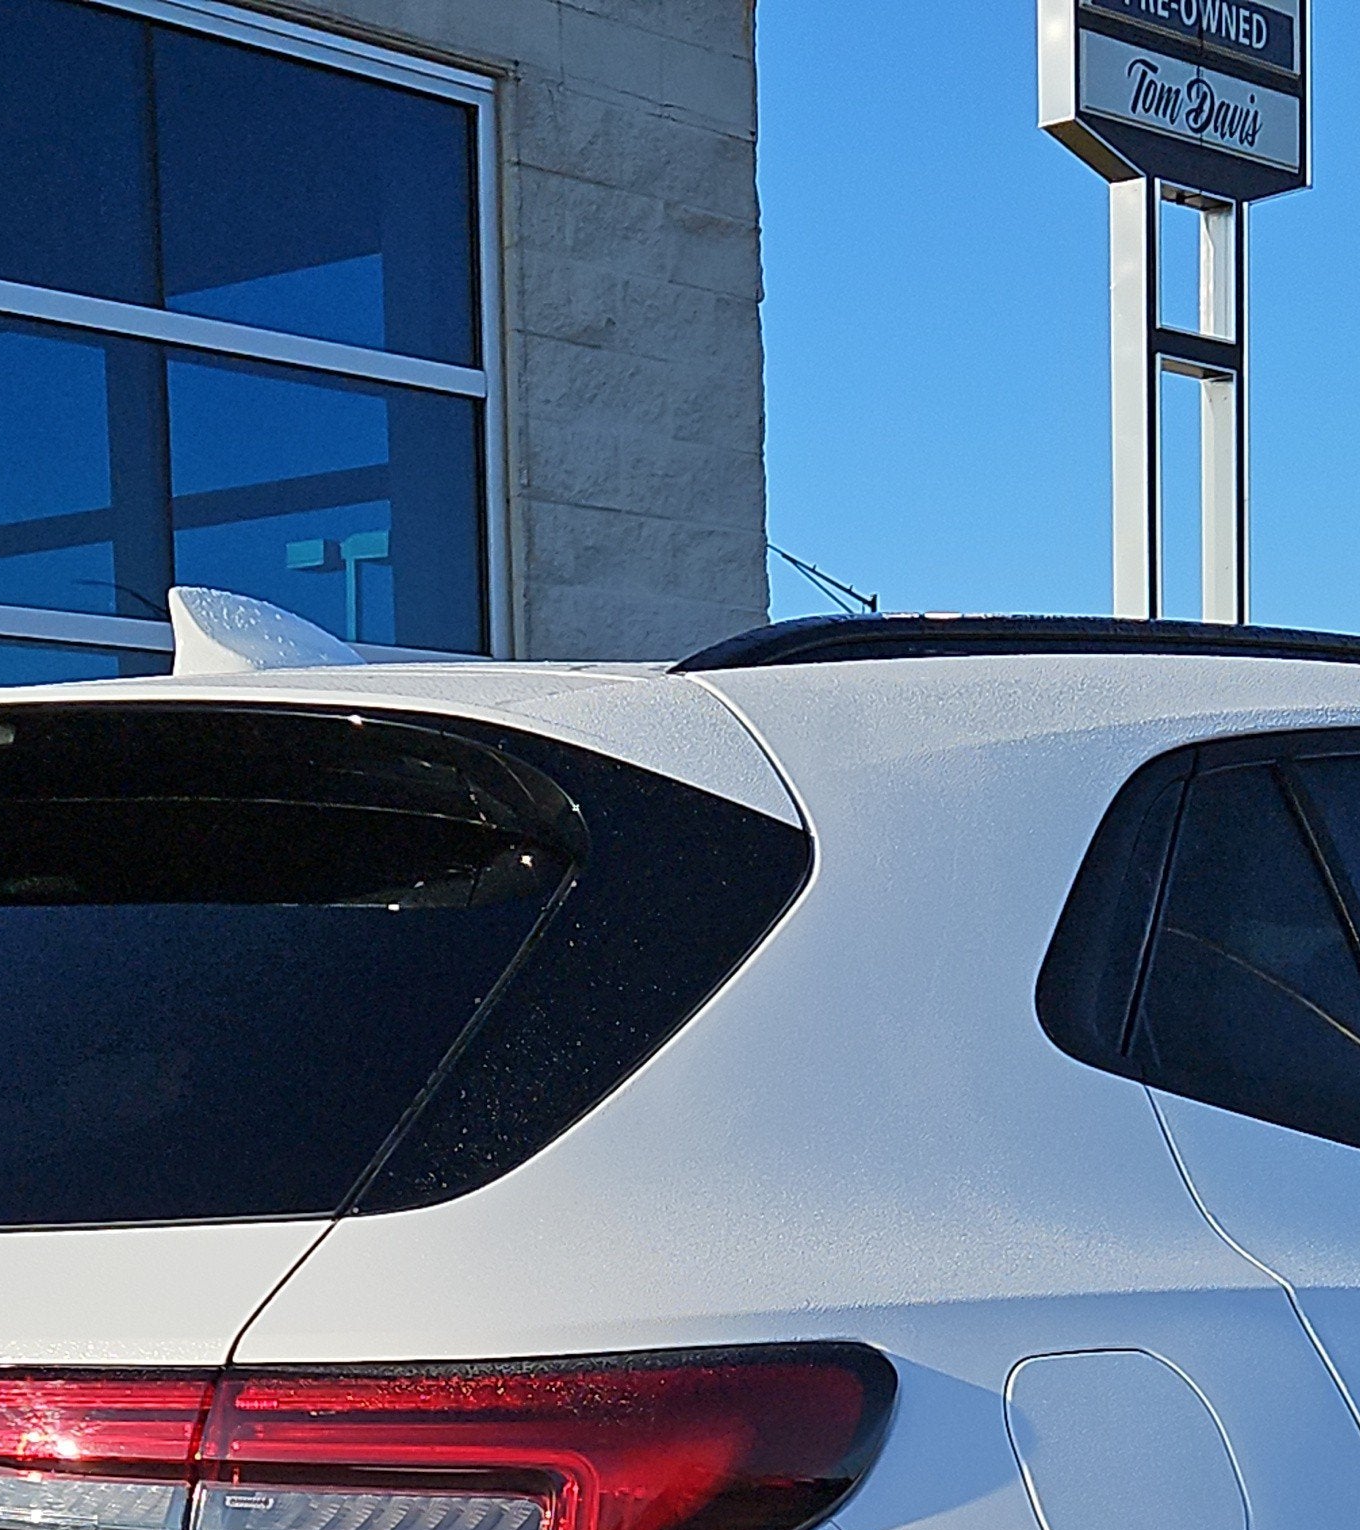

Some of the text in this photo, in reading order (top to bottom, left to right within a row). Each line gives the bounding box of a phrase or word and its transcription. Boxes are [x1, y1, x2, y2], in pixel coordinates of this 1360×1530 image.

[1124, 0, 1267, 49] E-OWNED
[1126, 58, 1264, 147] Tom Davis
